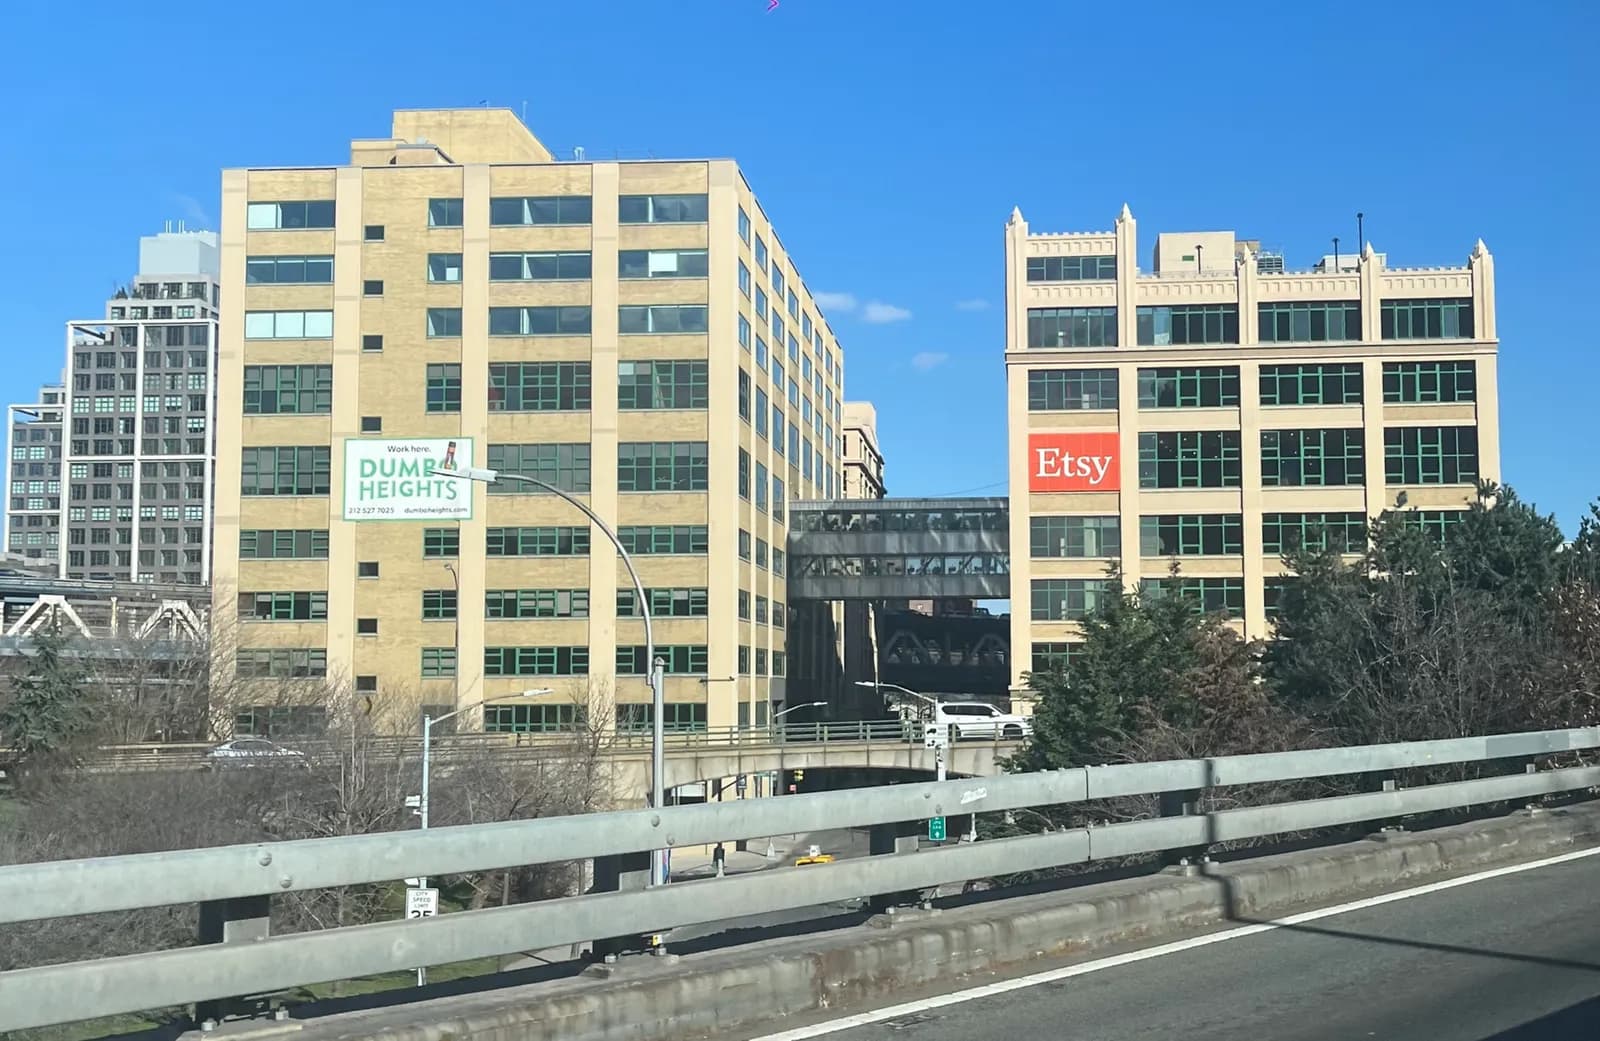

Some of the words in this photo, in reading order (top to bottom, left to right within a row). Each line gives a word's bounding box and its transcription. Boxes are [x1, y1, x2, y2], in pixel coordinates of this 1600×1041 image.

[387, 445, 410, 453] Work
[411, 445, 431, 453] here.
[1035, 448, 1112, 484] Etsy
[360, 480, 457, 500] HEIGHTS
